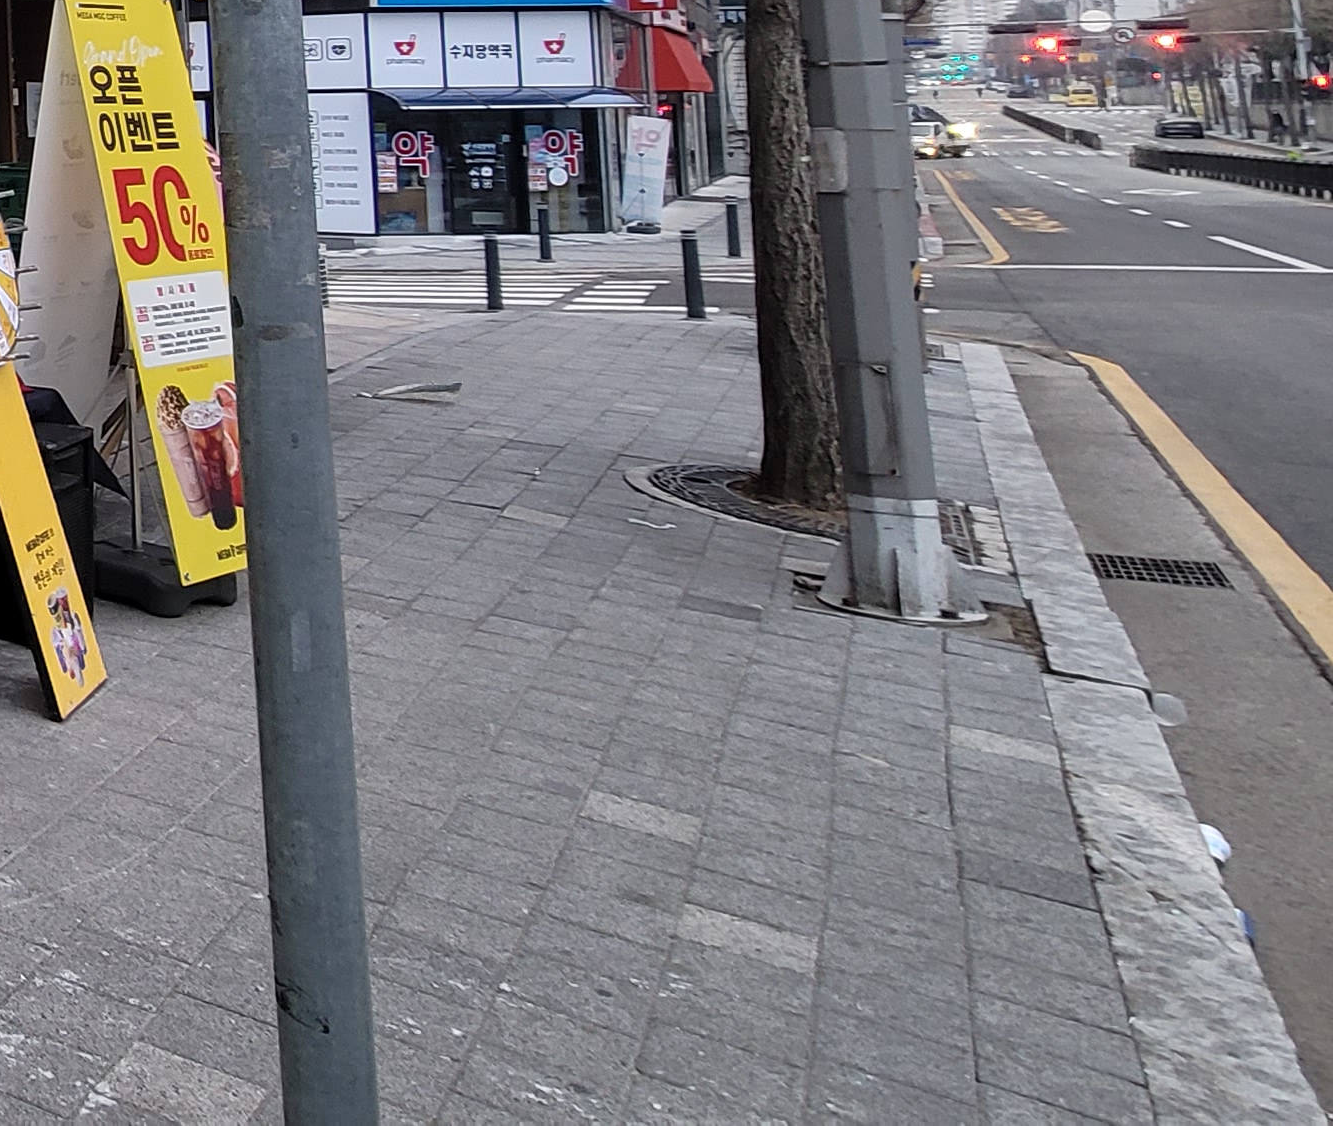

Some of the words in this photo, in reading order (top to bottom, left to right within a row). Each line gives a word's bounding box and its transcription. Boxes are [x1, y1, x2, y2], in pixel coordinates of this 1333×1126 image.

[449, 43, 513, 60] 수지당약국
[89, 65, 145, 105] 오픈
[99, 112, 181, 153] 이벤트
[543, 129, 584, 177] 약
[392, 130, 435, 178] 약
